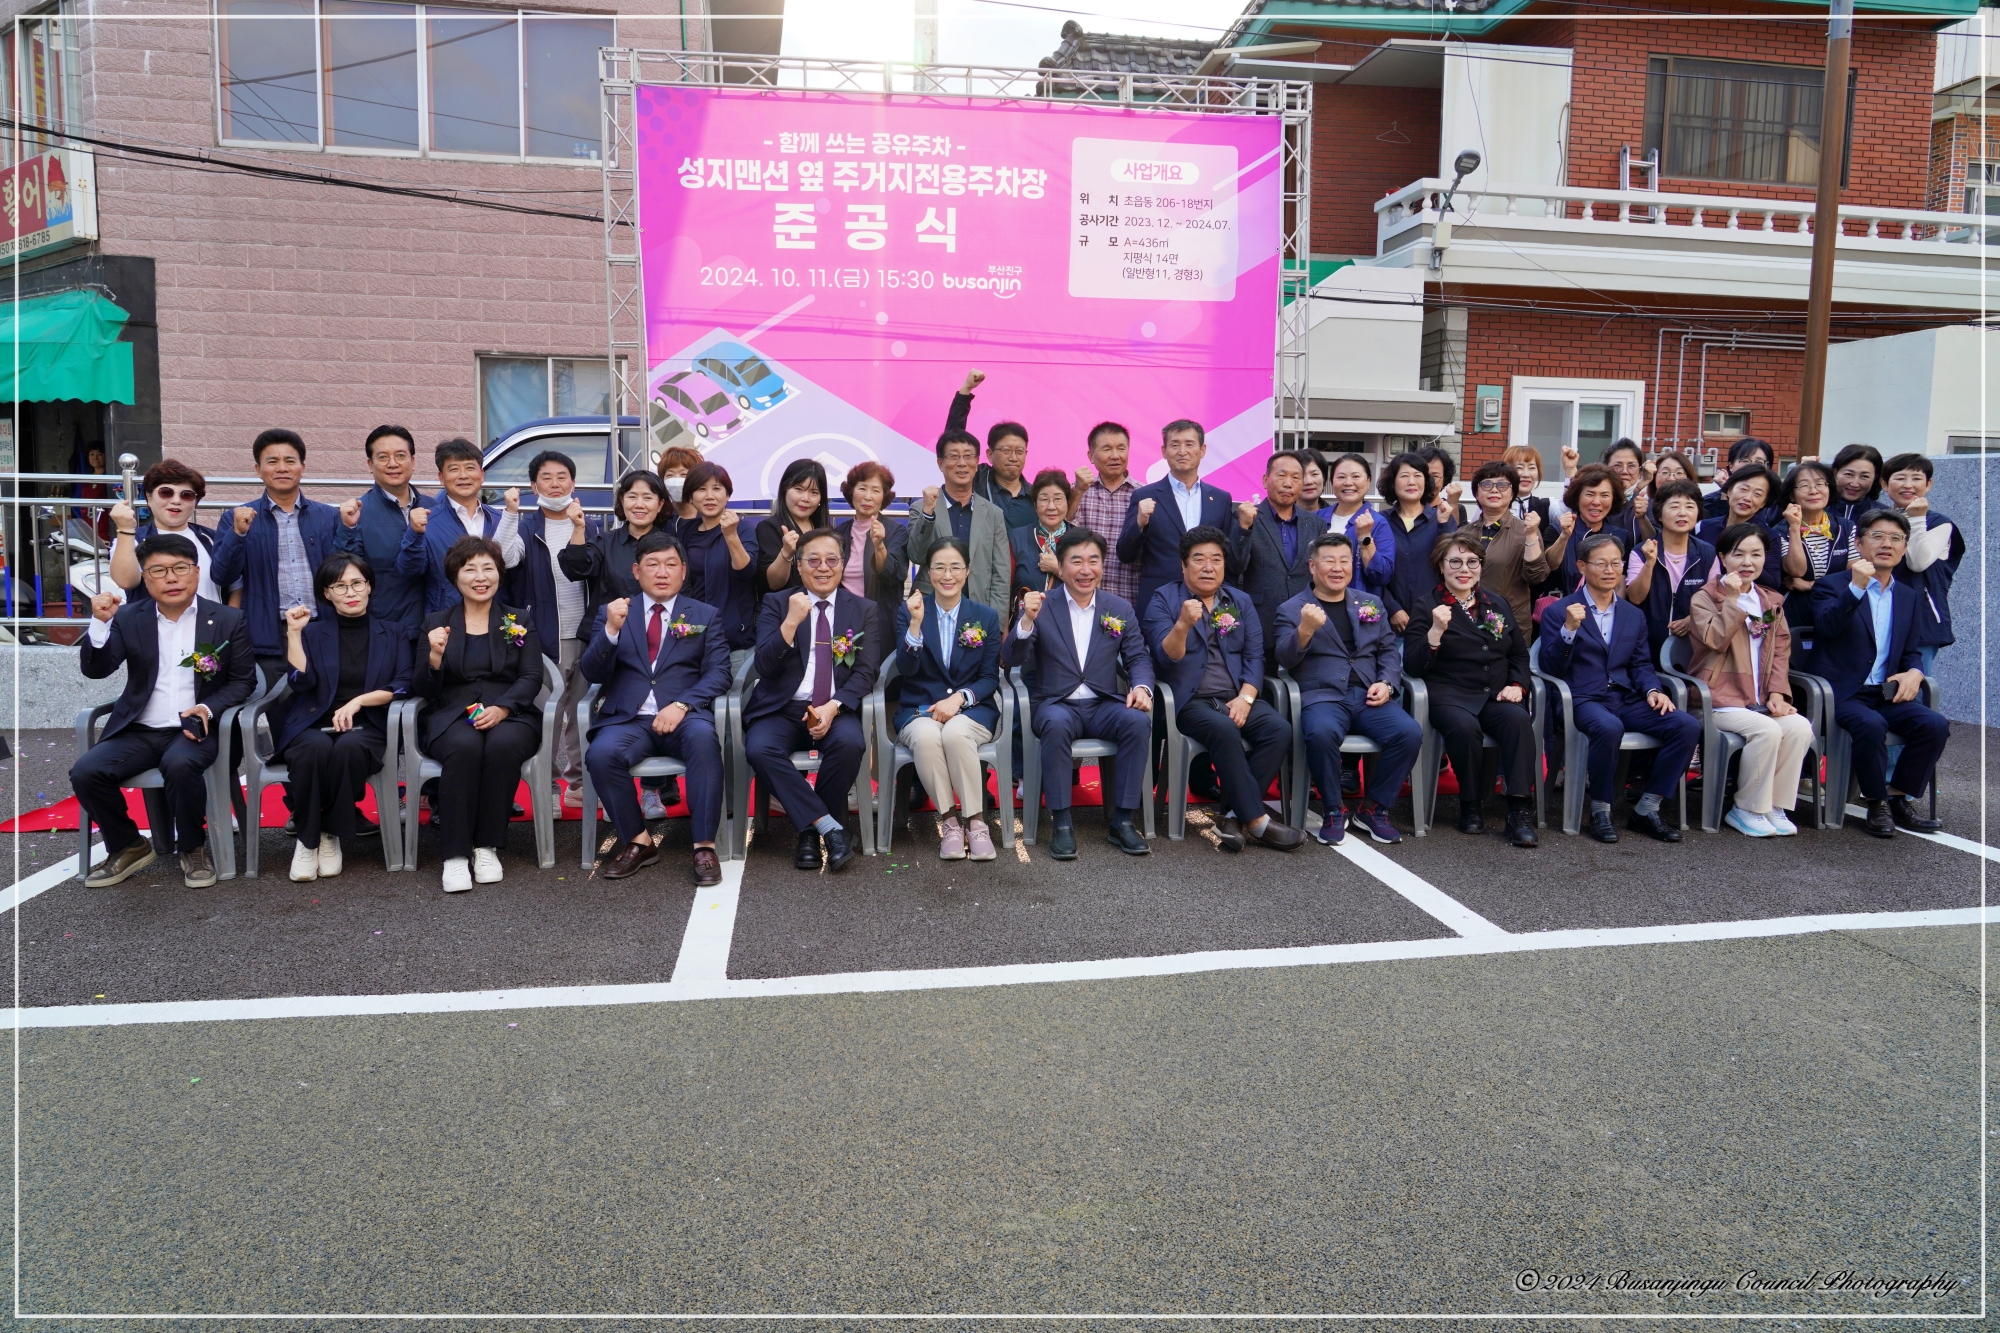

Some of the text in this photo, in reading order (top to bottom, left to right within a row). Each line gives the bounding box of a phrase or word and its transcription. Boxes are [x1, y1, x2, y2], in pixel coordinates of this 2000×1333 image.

[779, 132, 819, 154] 함께
[826, 133, 866, 154] 쓰는
[871, 133, 951, 157] 공유주차
[678, 157, 1047, 199] 성지맨션 옆 주거지전용주차장
[1123, 162, 1183, 182] 사업개요
[1123, 195, 1153, 208] 초읍동
[1156, 197, 1213, 211] 206-18번지
[1079, 214, 1119, 227] 공사기간
[1123, 252, 1179, 265] 지평식 14면
[700, 267, 934, 290] 2024. 10. 11.(금) 15:30
[988, 265, 1022, 276] 부산진구
[1122, 267, 1204, 281] (일반형11, 경형3)
[943, 273, 1021, 294] busanjin
